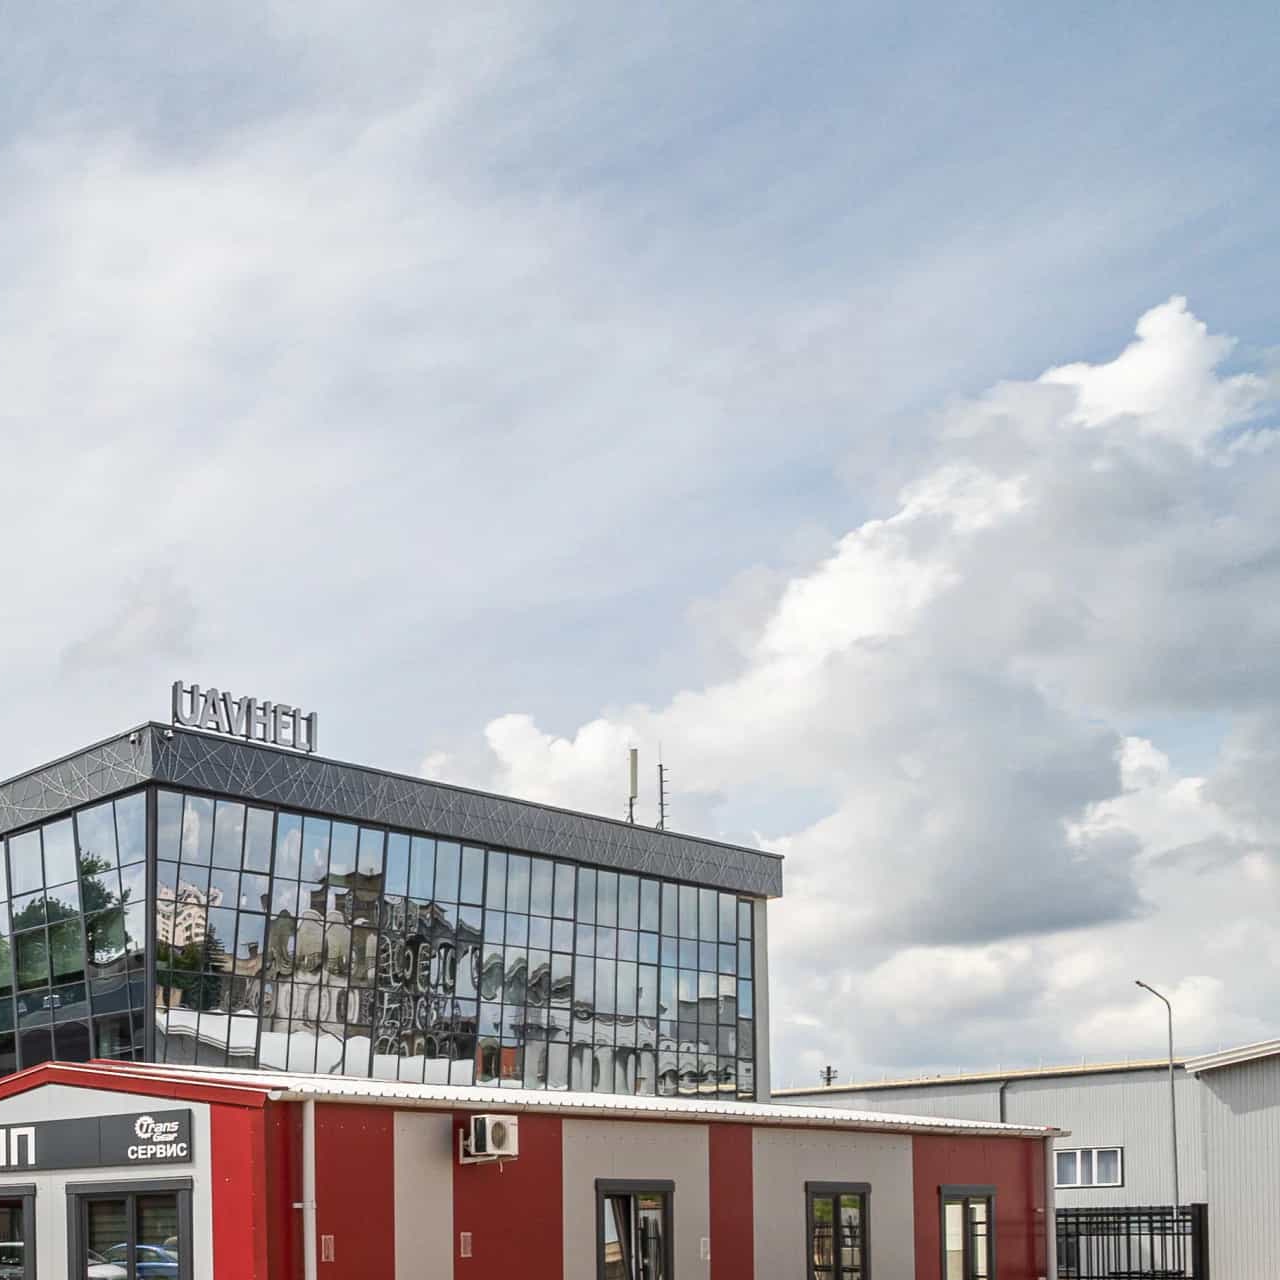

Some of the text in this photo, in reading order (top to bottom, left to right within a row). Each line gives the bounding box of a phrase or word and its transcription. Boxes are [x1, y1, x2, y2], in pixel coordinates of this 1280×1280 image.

[172, 680, 318, 753] UAVHELI
[139, 1119, 179, 1133] Trans
[127, 1142, 188, 1160] СЕРВИС
